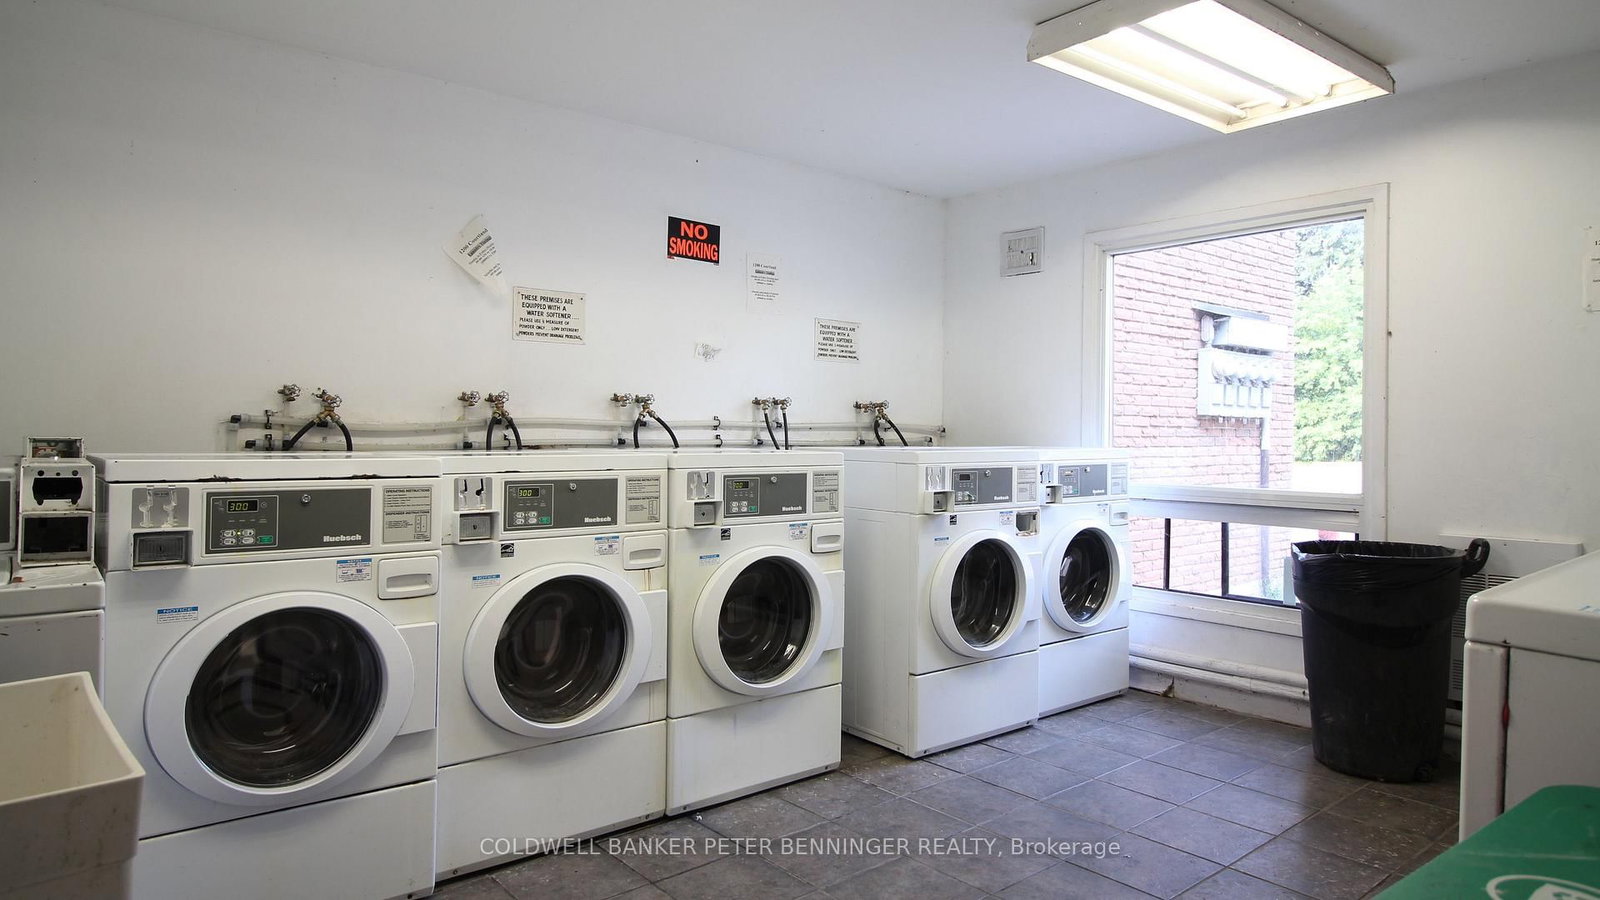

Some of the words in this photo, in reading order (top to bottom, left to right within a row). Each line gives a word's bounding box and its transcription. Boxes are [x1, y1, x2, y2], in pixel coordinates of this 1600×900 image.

[680, 220, 708, 240] NO
[669, 236, 718, 261] SMOKING
[521, 294, 538, 302] THESE
[540, 296, 563, 304] PREMISES
[230, 502, 249, 511] 300
[323, 534, 362, 542] Huebsch
